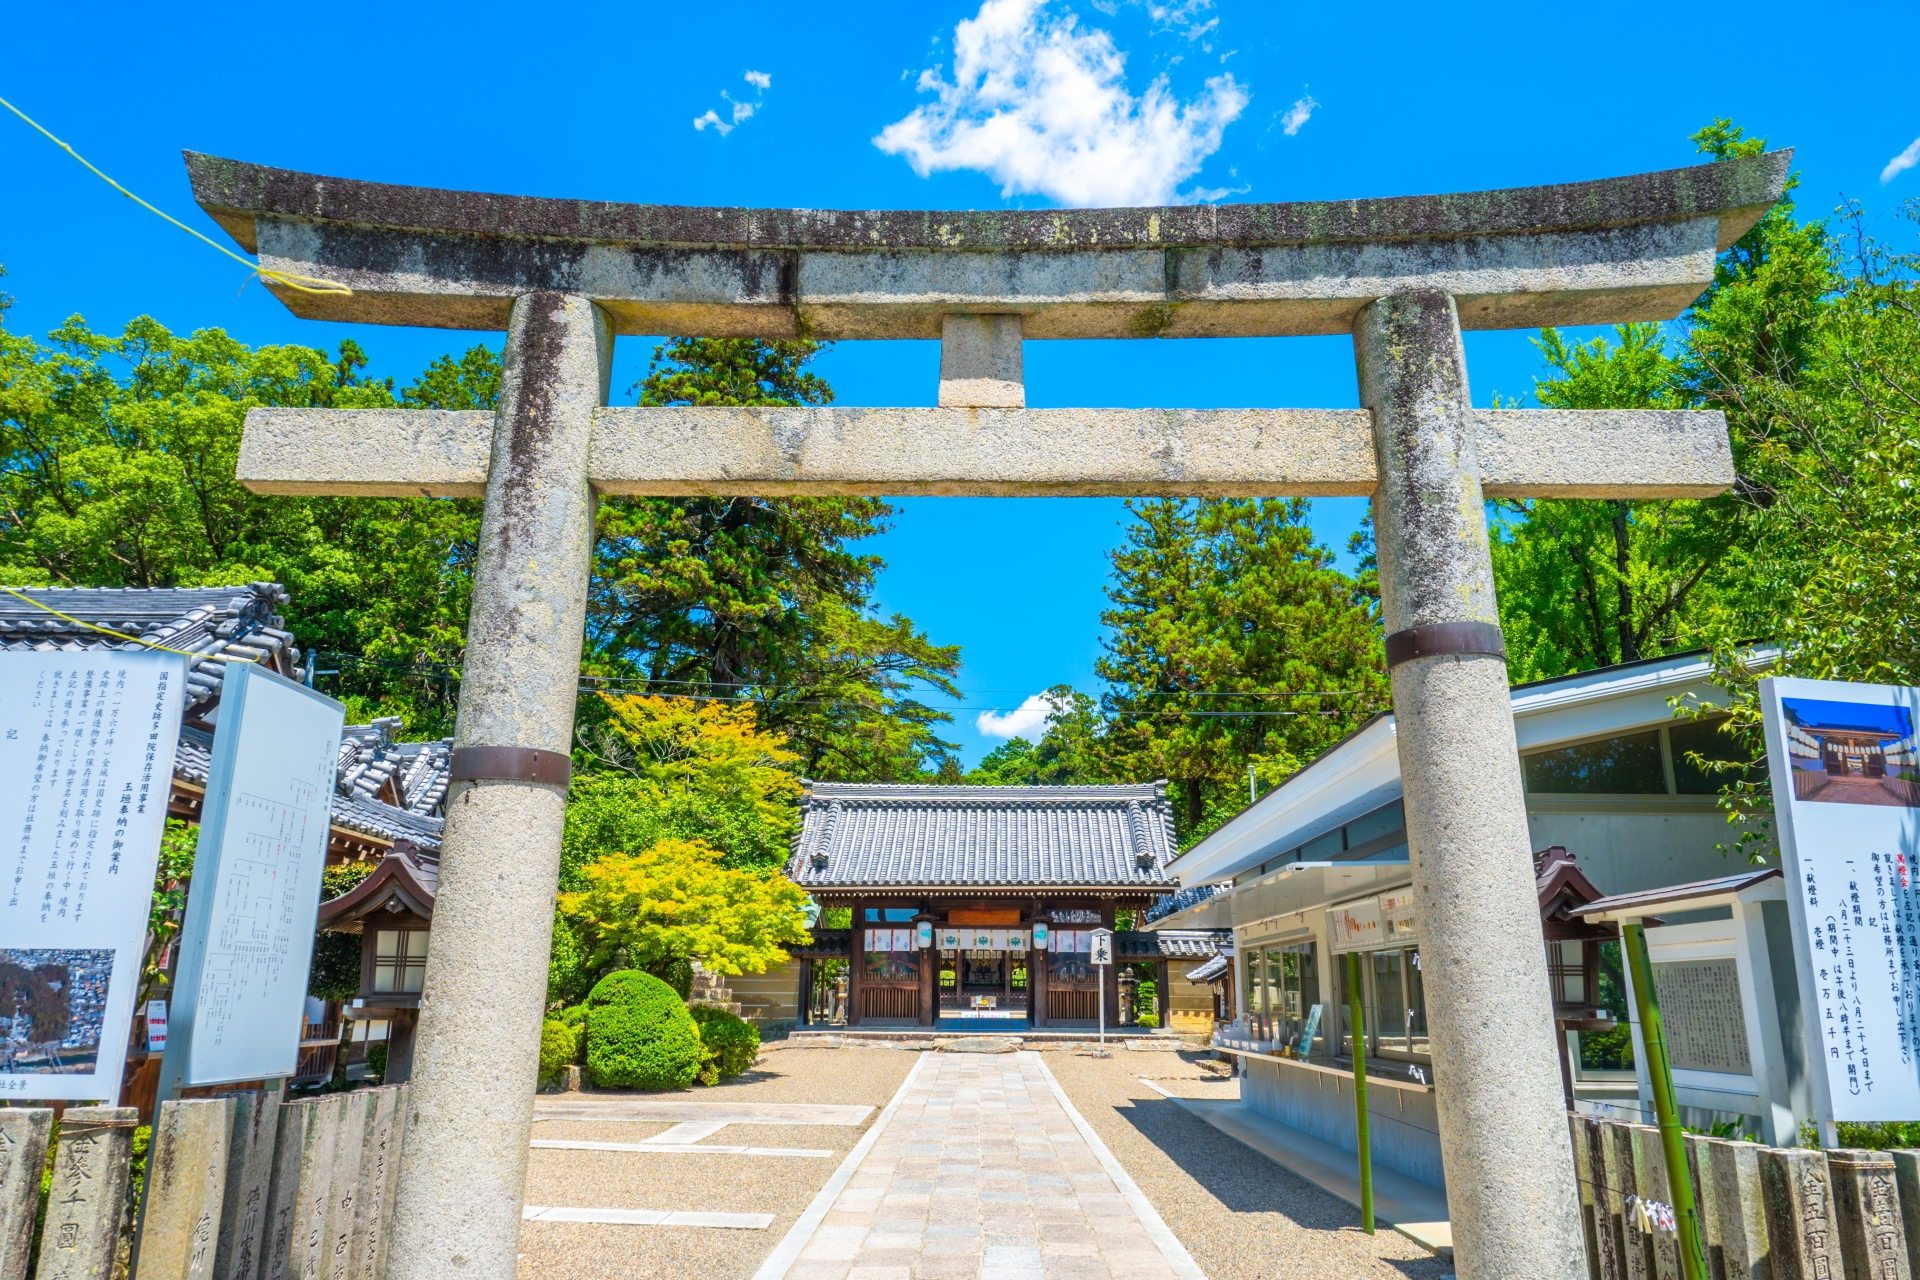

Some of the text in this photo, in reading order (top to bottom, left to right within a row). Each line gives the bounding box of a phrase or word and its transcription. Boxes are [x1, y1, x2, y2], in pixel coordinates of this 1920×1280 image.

[33, 670, 45, 708] ください
[6, 728, 18, 740] 記
[49, 669, 78, 788] 左記の通り承っております
[137, 671, 168, 814] 国指定史跡多田院保存活用事業
[108, 782, 133, 875] 玉垣奉納の御案内
[1868, 917, 1878, 927] 記
